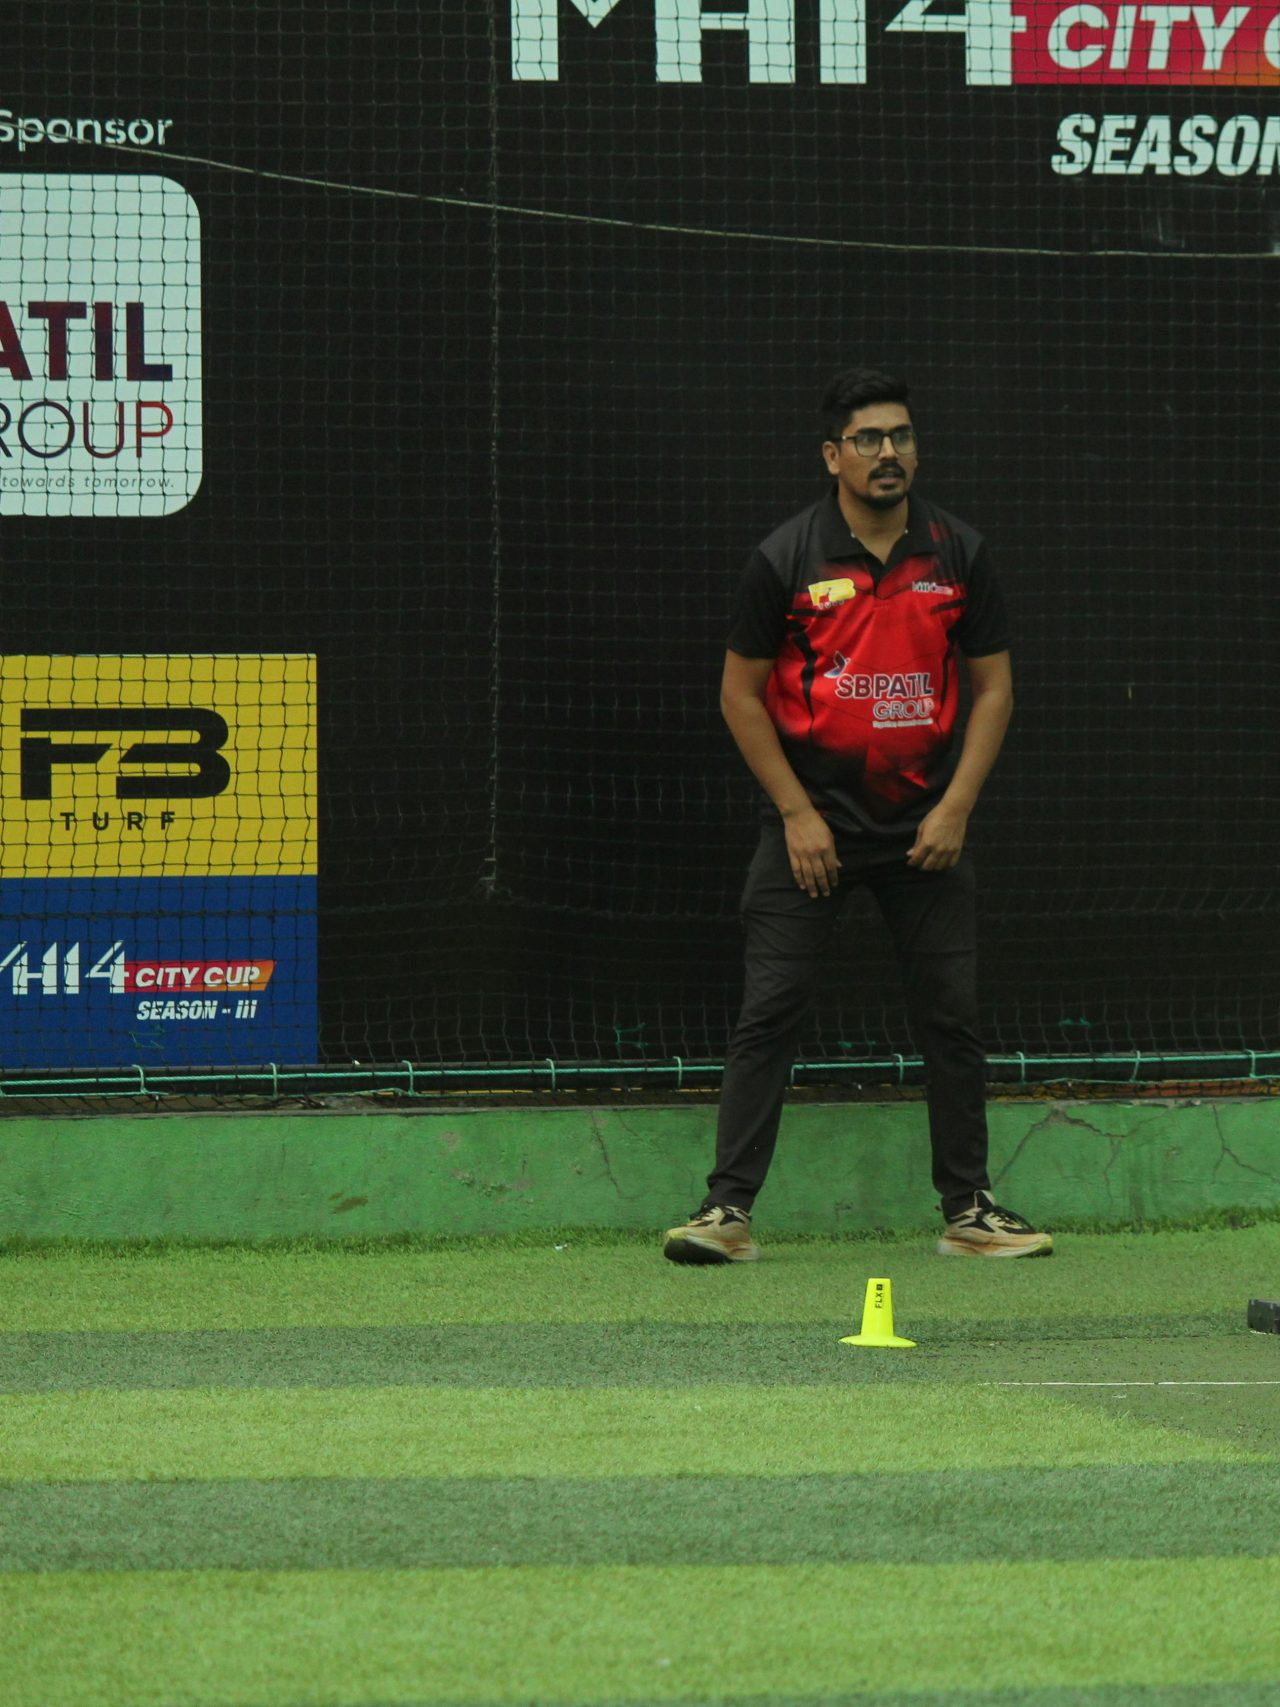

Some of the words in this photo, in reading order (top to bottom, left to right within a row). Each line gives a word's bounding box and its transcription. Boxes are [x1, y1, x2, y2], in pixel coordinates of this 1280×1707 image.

[1047, 4, 1249, 71] CITY
[2, 475, 75, 488] towards
[85, 475, 174, 488] tomorrow.
[873, 698, 935, 720] GROUP
[60, 812, 175, 830] TURF
[135, 967, 202, 988] CITY
[203, 966, 260, 987] CUP
[136, 1000, 218, 1019] SEASON
